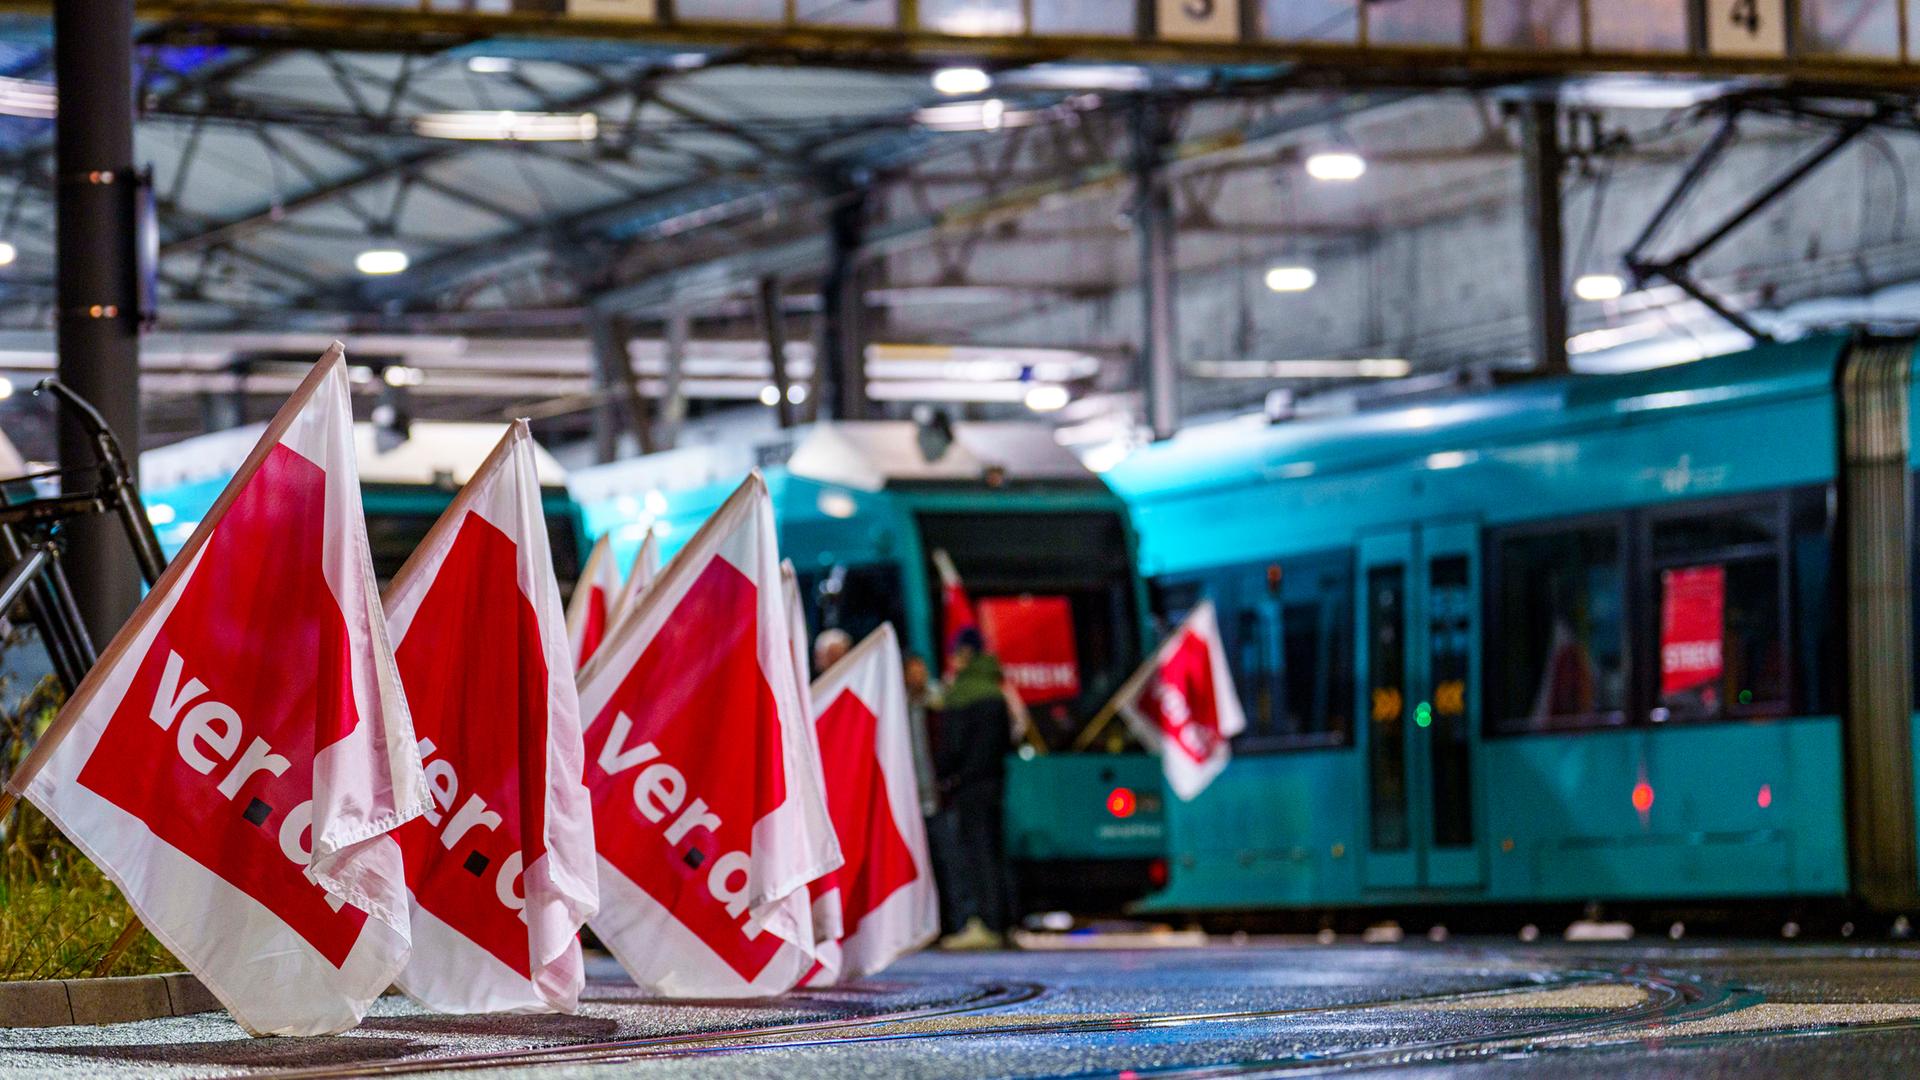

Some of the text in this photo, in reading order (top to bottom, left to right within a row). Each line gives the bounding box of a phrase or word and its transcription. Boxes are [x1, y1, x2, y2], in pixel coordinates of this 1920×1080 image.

[149, 648, 346, 913] ver.
[1003, 663, 1073, 689] TREIK
[597, 710, 765, 941] ver.d
